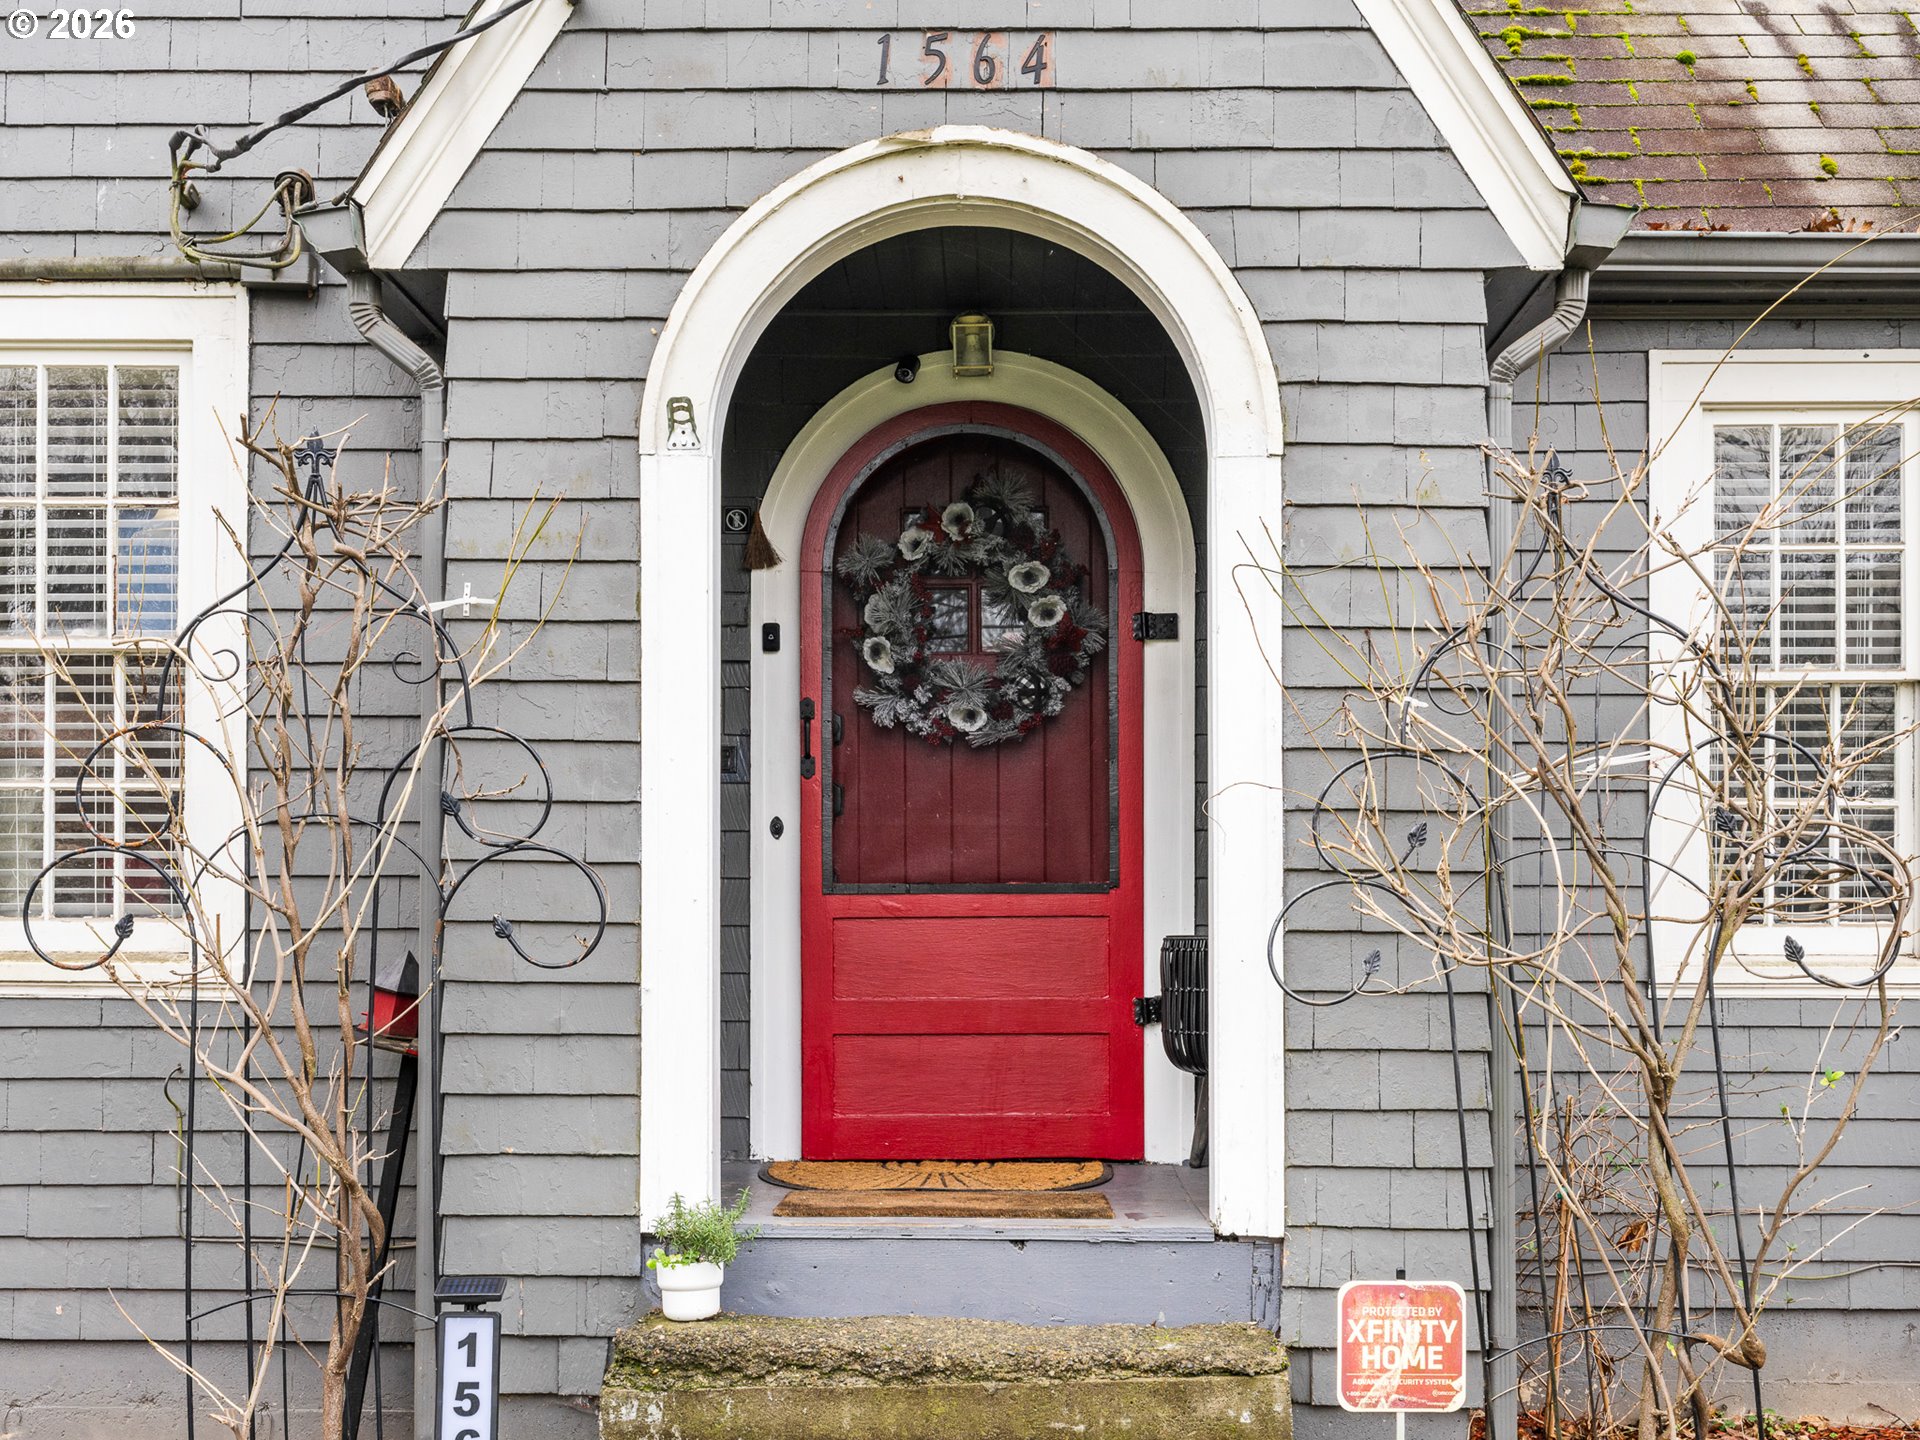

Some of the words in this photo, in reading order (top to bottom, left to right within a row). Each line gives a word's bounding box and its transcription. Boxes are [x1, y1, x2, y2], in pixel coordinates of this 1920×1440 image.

[877, 32, 1048, 86] 1564
[1428, 1306, 1443, 1317] BY
[1347, 1319, 1458, 1344] XFINITY
[1361, 1345, 1443, 1370] HOME
[1425, 1378, 1452, 1386] SYSTEM
